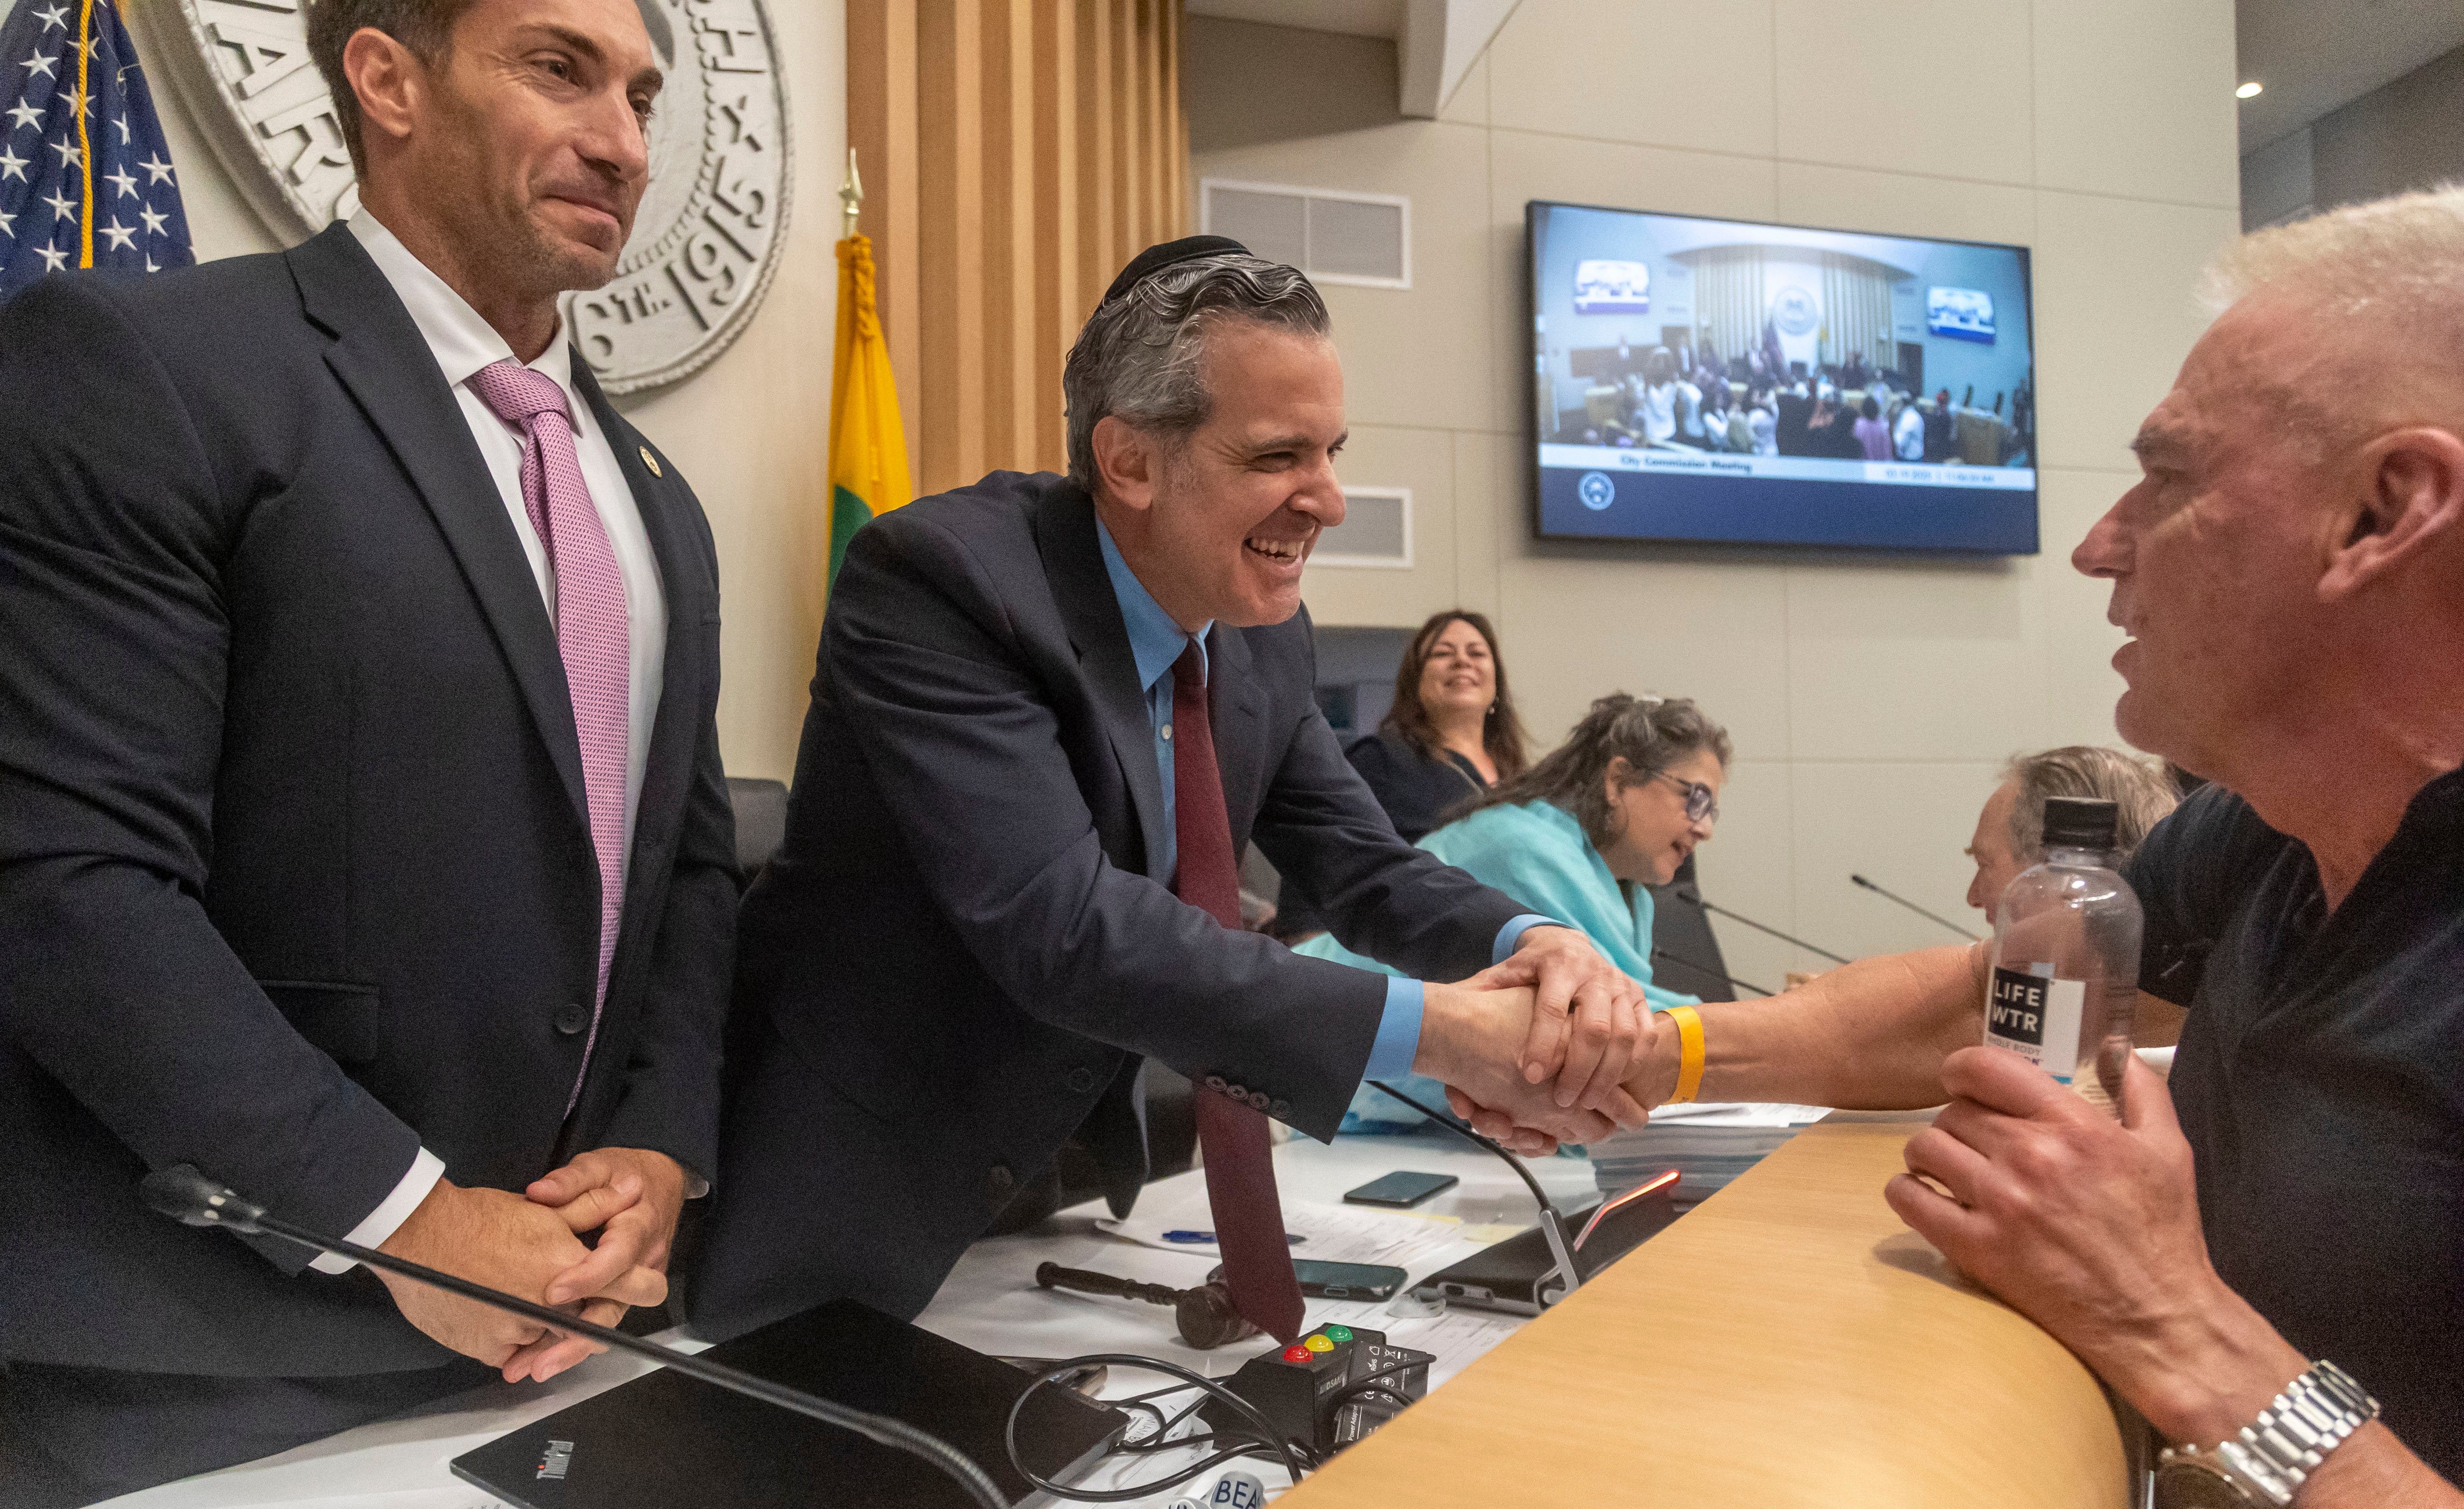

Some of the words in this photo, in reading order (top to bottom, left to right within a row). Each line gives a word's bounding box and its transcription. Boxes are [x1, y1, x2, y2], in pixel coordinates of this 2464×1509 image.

[664, 154, 766, 332] 1915
[1621, 455, 1640, 467] City
[1644, 456, 1705, 468] Commission
[1711, 460, 1751, 473] Meeting
[1995, 979, 2041, 1007] LIFE
[1993, 1003, 2038, 1032] WTR
